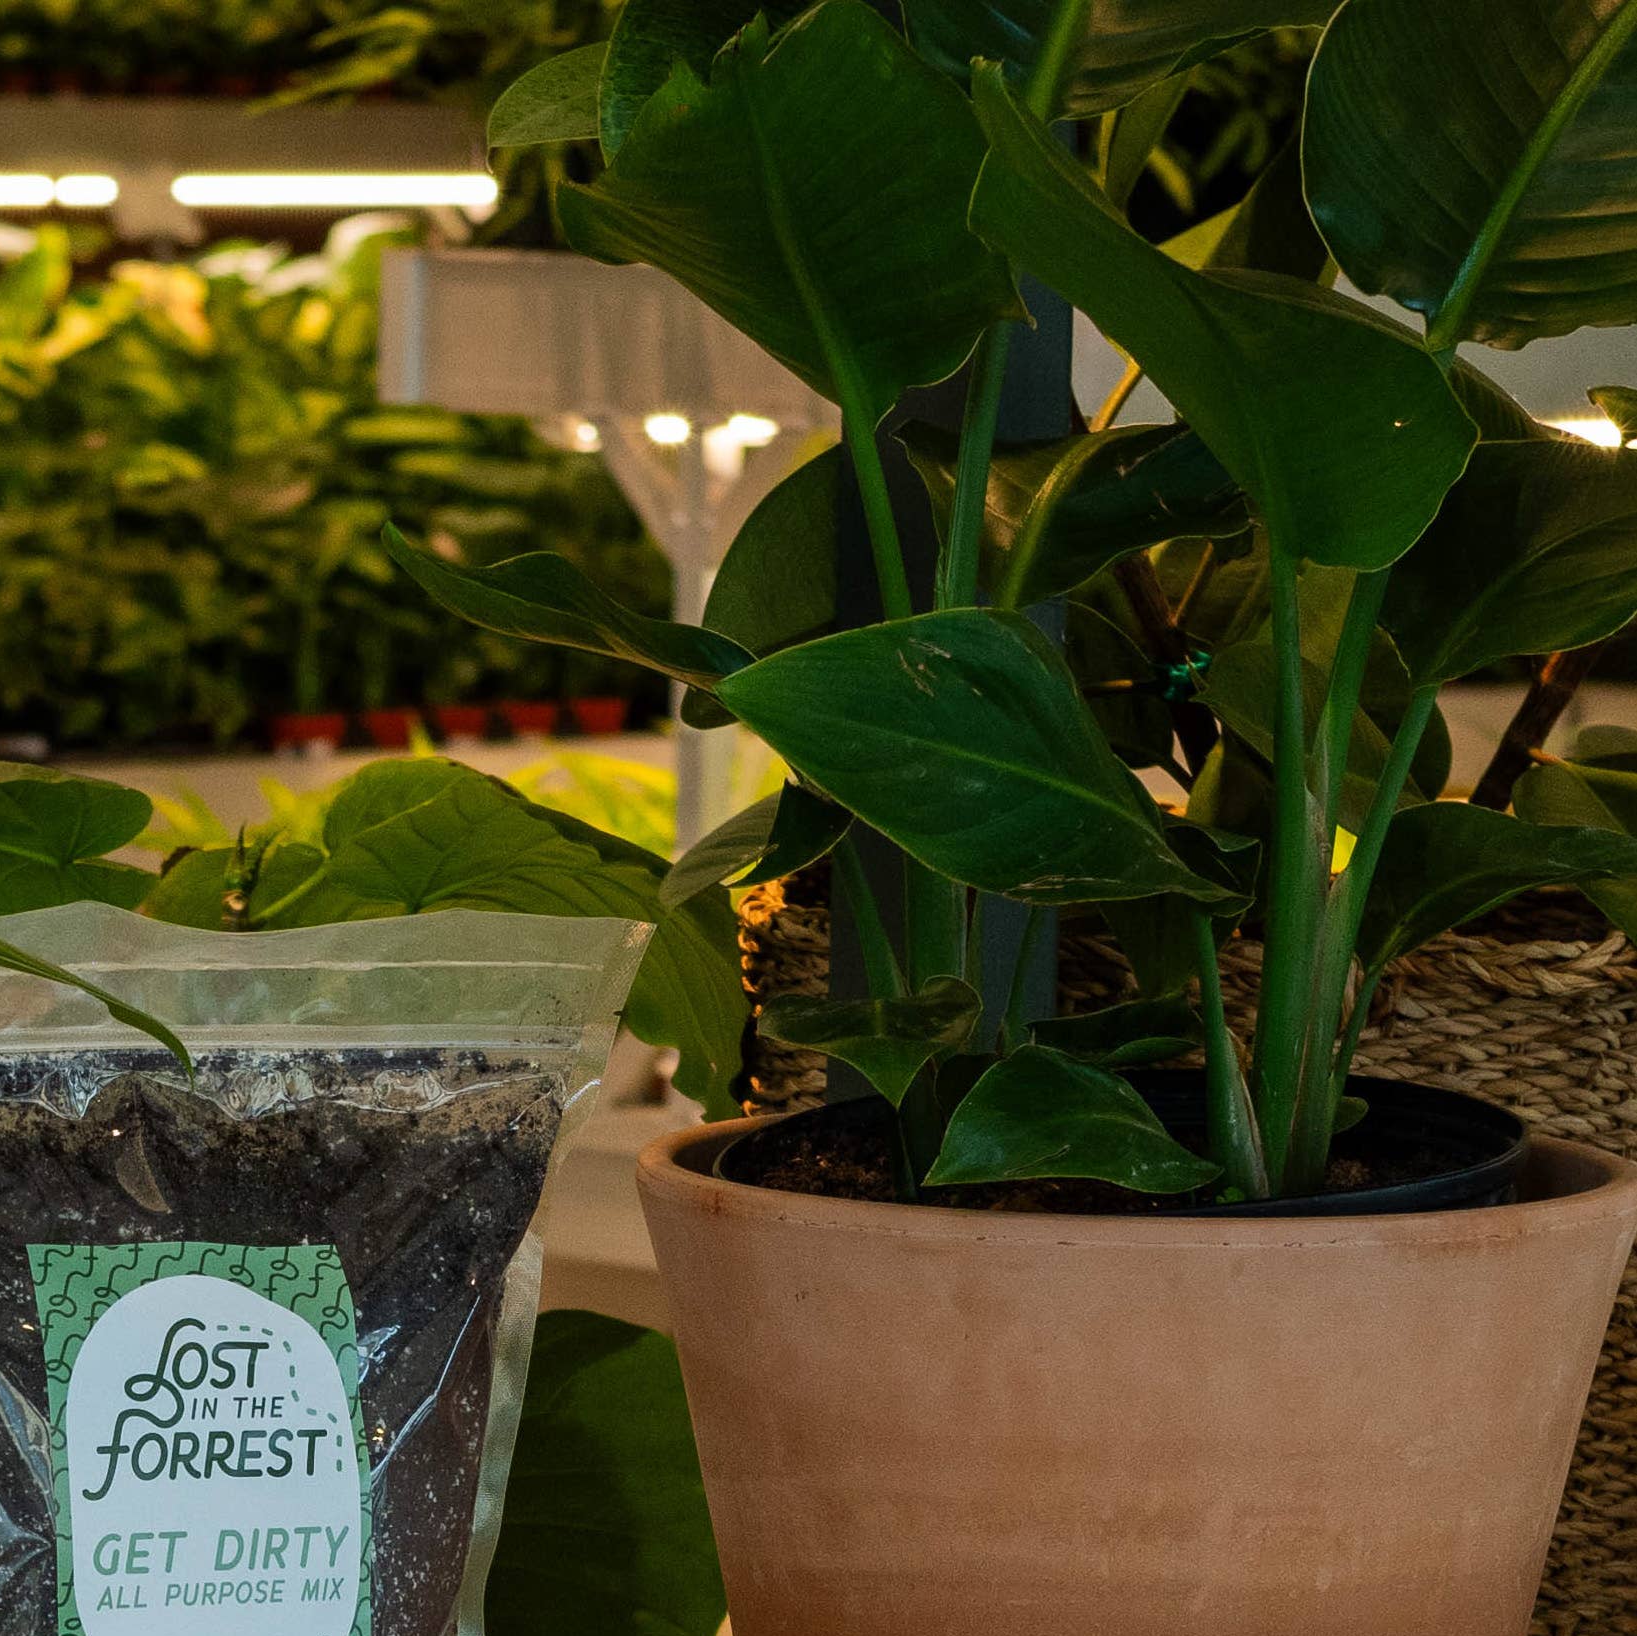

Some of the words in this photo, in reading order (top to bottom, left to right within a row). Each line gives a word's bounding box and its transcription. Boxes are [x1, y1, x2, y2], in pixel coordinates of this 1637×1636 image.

[124, 1317, 269, 1402] LOST
[191, 1397, 216, 1419] IN
[233, 1397, 284, 1418] THE
[82, 1410, 327, 1501] FORREST
[92, 1531, 188, 1576] GET
[215, 1525, 349, 1572] DIRTY
[97, 1586, 147, 1612] ALL
[165, 1580, 286, 1607] PURPOSE
[302, 1578, 344, 1600] MIX
